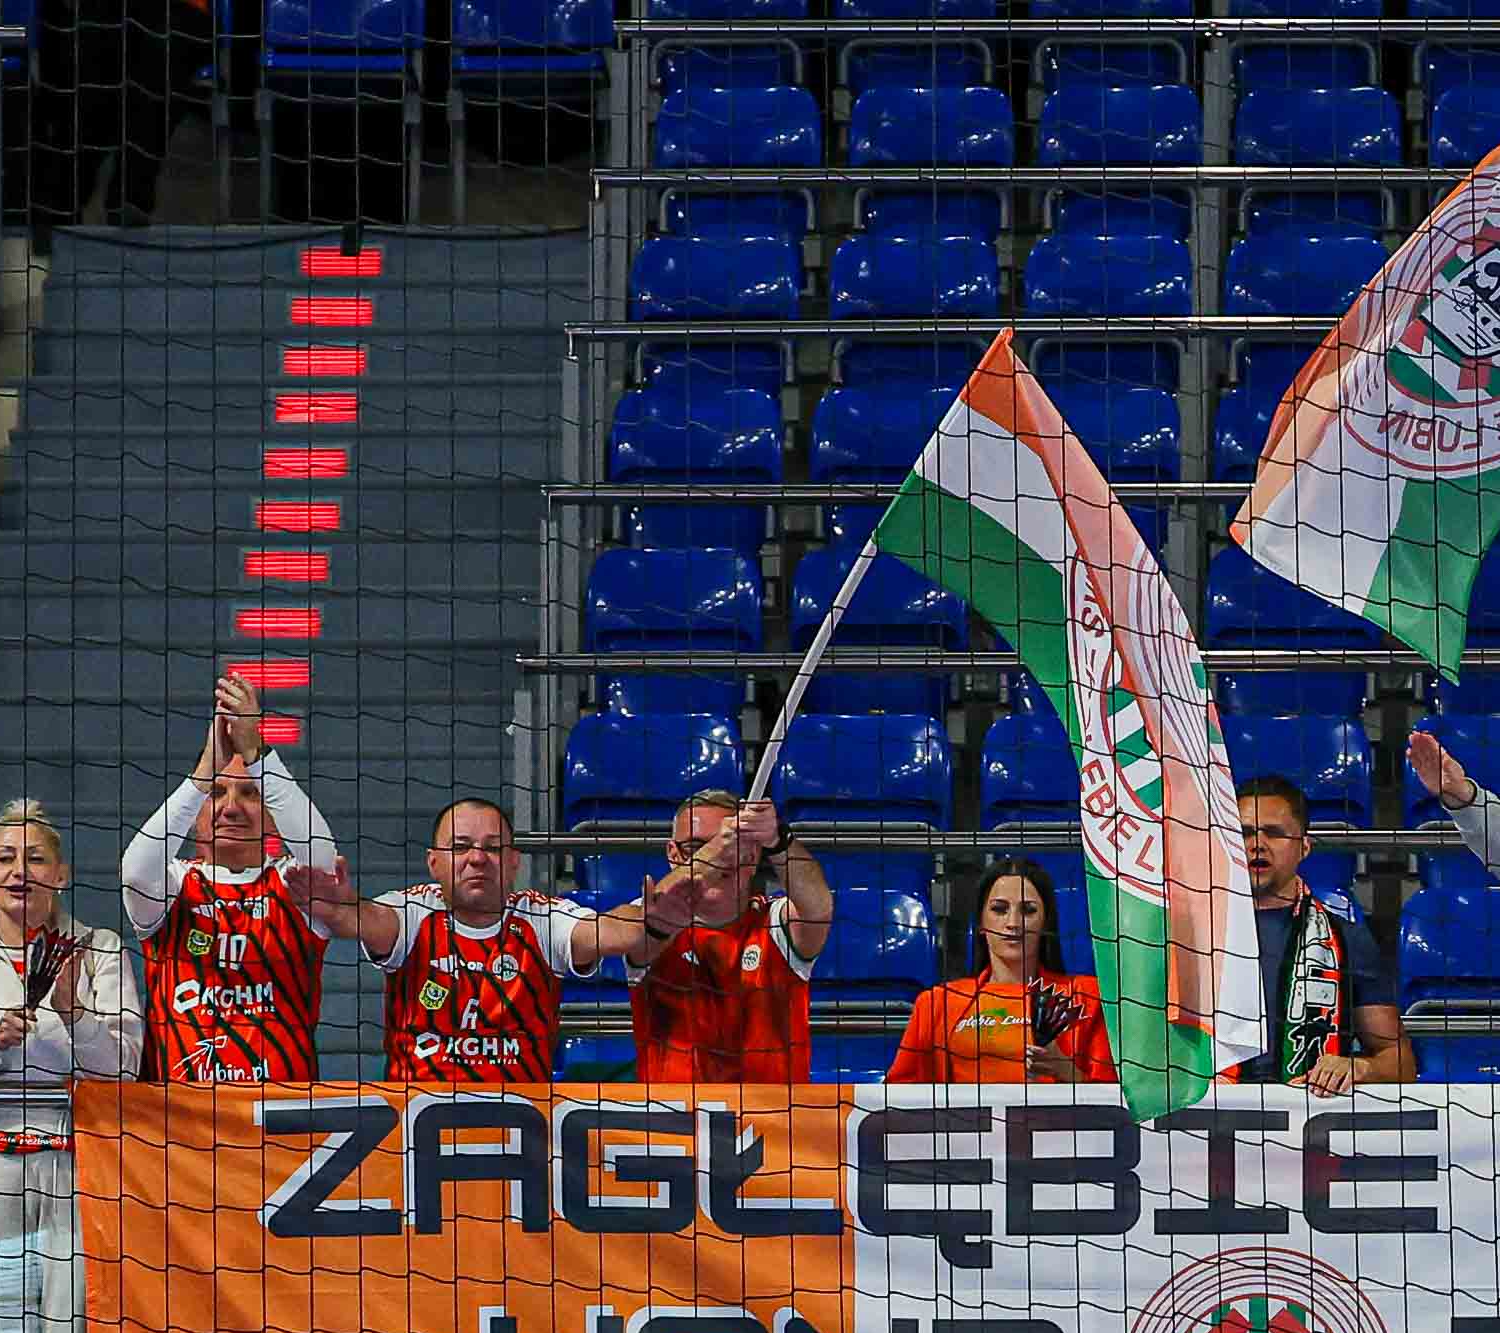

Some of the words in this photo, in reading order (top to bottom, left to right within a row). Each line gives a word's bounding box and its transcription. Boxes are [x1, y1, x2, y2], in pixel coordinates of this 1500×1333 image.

[202, 982, 274, 1007] KGHM
[445, 1037, 520, 1056] KGHM
[198, 1058, 270, 1081] lubin.pl
[253, 1095, 1440, 1268] ZAGŁĘBIE
